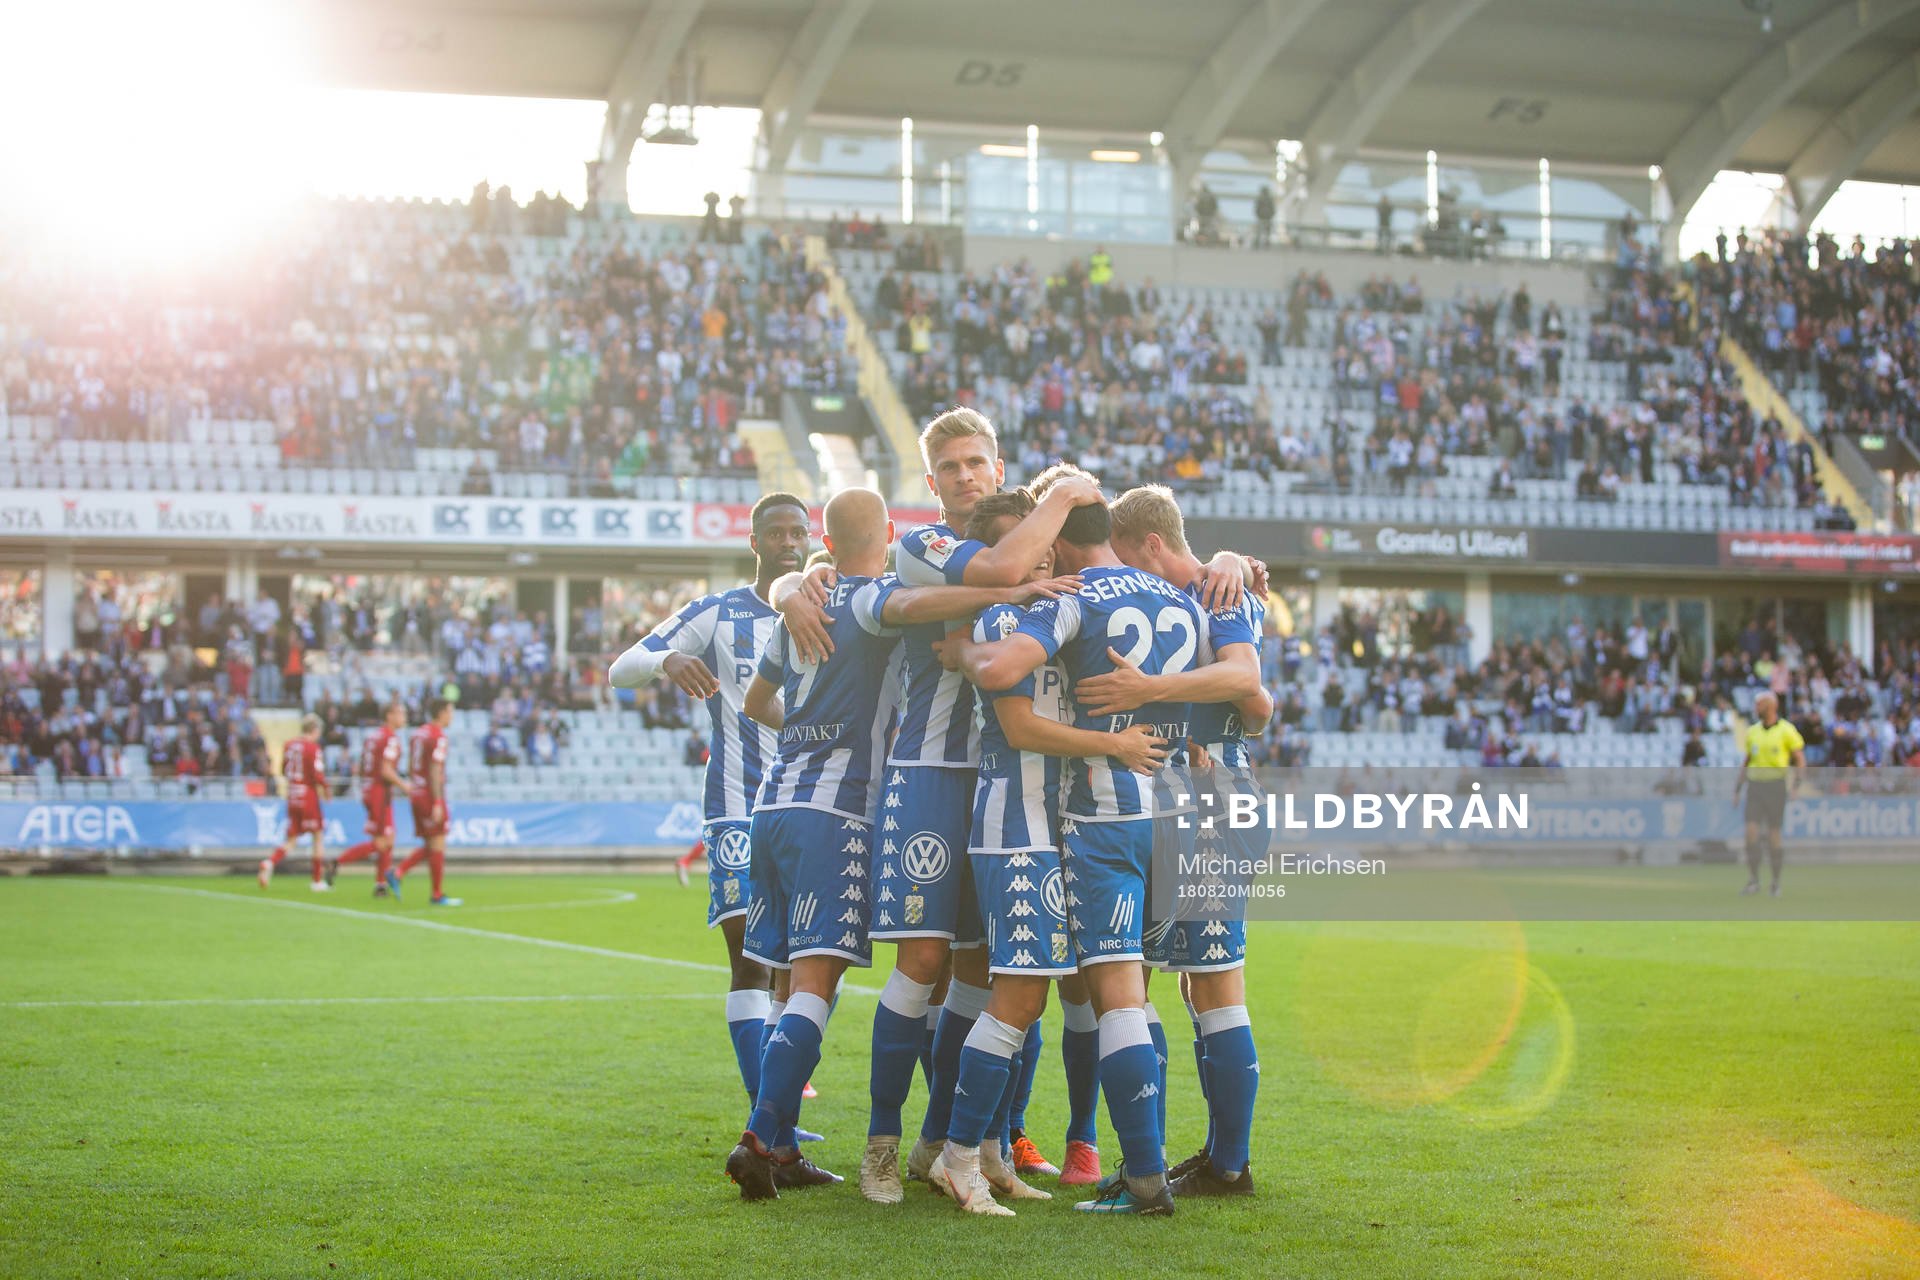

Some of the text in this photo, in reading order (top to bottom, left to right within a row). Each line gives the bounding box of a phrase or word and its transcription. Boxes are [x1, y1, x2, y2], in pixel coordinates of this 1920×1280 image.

[954, 60, 1026, 87] D5
[0, 507, 43, 528] STA
[63, 506, 138, 530] RASTA
[157, 508, 231, 531] RASTA
[252, 510, 325, 533] RASTA
[343, 512, 417, 535] RASTA
[1376, 526, 1457, 555] Gamla
[1459, 529, 1529, 558] Ullevi
[1079, 572, 1185, 604] SERNEKE
[728, 608, 755, 619] RASTA
[1107, 606, 1197, 675] 22
[446, 817, 519, 844] ASTA
[1784, 800, 1911, 838] Prioritet
[800, 934, 823, 945] Group
[1100, 939, 1122, 950] NRC
